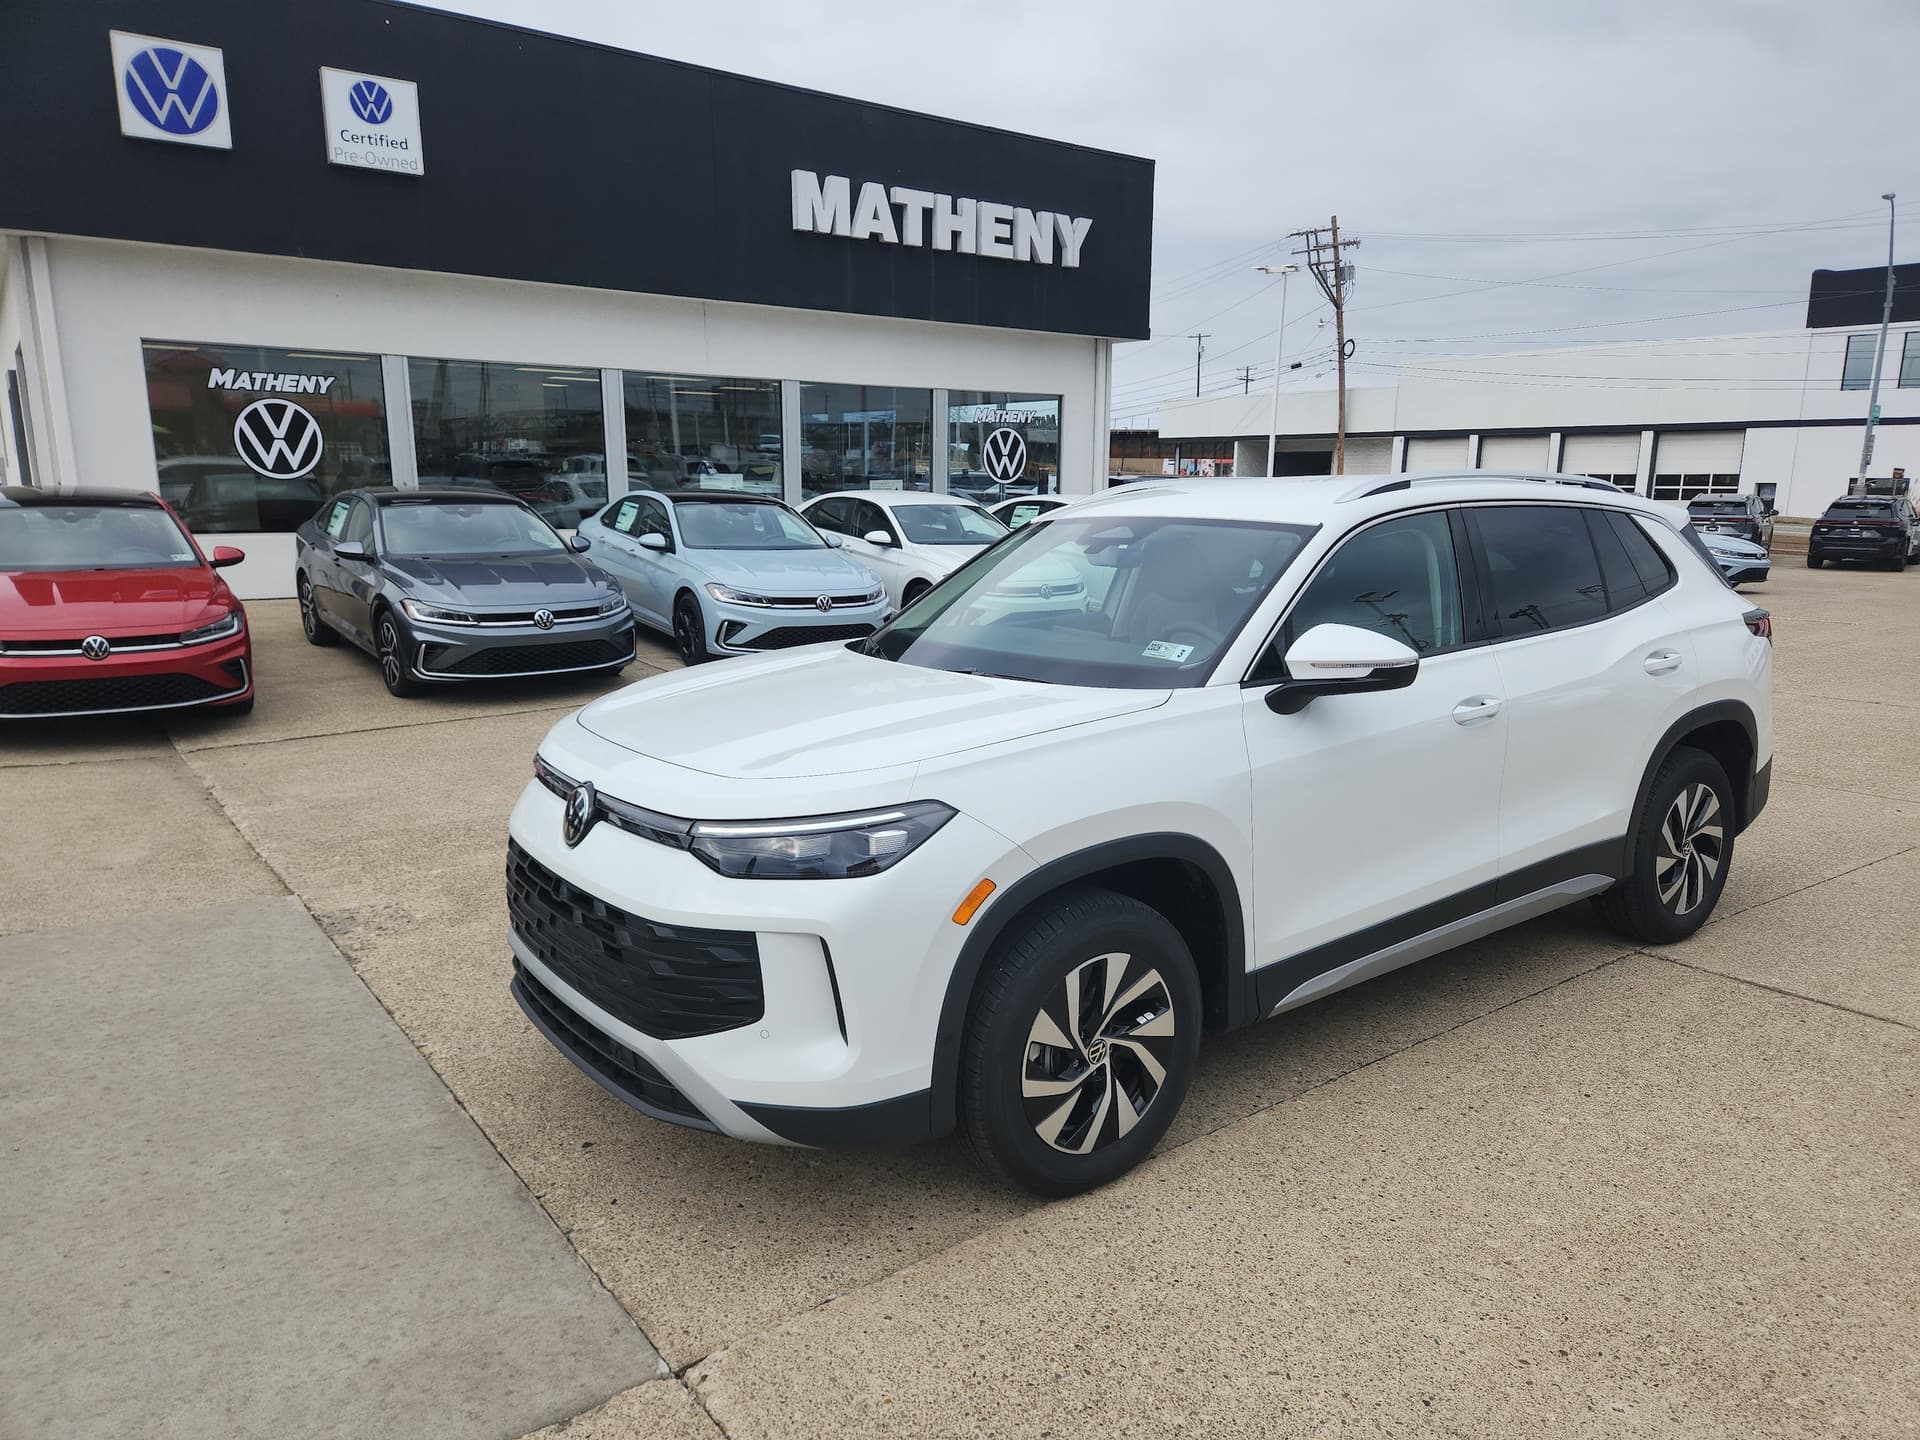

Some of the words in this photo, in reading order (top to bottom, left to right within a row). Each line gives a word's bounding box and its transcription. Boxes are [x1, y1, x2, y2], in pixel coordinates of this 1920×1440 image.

[126, 48, 217, 134] VW
[350, 80, 393, 124] VW
[334, 147, 419, 171] Pre-Owned
[340, 129, 409, 151] Certified
[791, 168, 1093, 269] MATHENY
[208, 367, 335, 394] MATHENY
[974, 407, 1036, 424] MATHENY
[235, 399, 323, 479] VW
[984, 428, 1026, 483] VW
